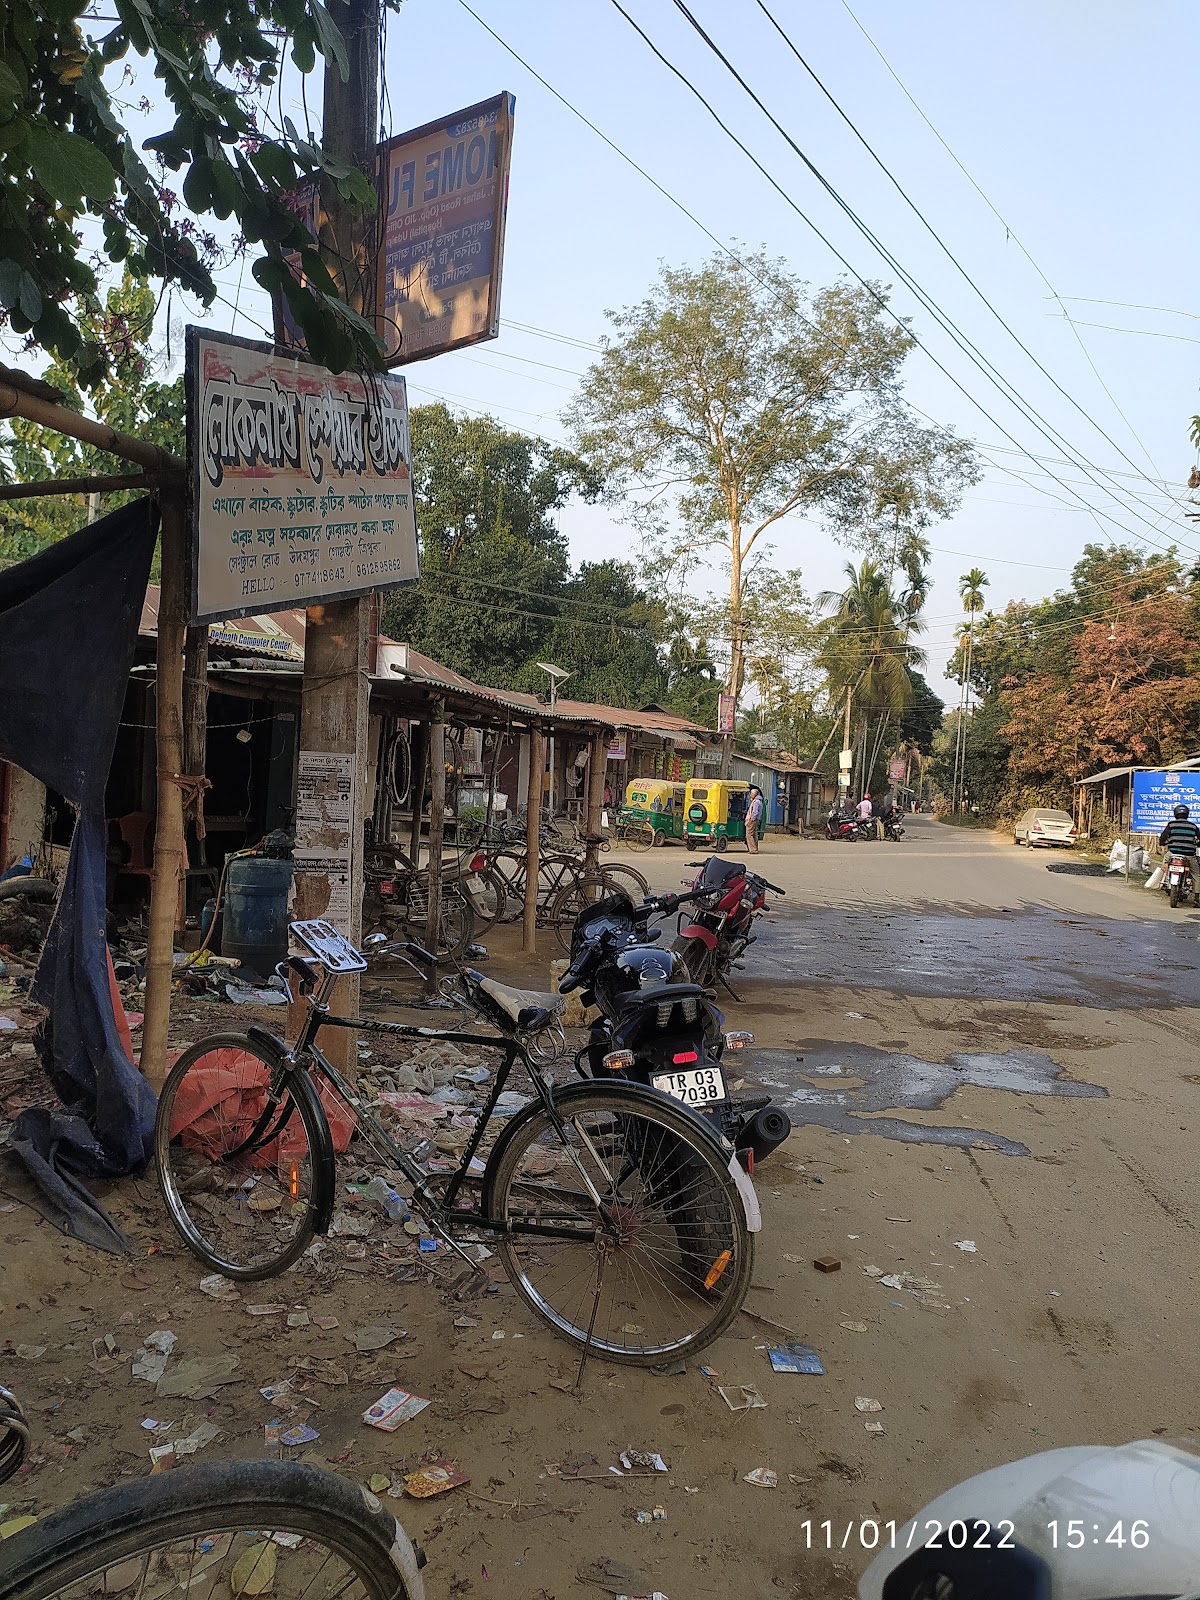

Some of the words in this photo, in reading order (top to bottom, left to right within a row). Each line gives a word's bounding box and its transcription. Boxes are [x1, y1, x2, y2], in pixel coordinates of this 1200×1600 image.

[203, 370, 302, 488] লোকনাথ
[212, 497, 246, 517] এখানে
[395, 494, 409, 511] যায়
[279, 525, 323, 546] সহকারে
[325, 522, 358, 541] মেরামত
[361, 520, 379, 536] করা
[242, 576, 275, 596] HELLO
[356, 558, 401, 577] 9612595862
[238, 633, 270, 648] Computer
[270, 637, 291, 651] Center
[667, 1074, 688, 1090] TR
[694, 1070, 714, 1086] 03
[677, 1085, 718, 1102] 7038
